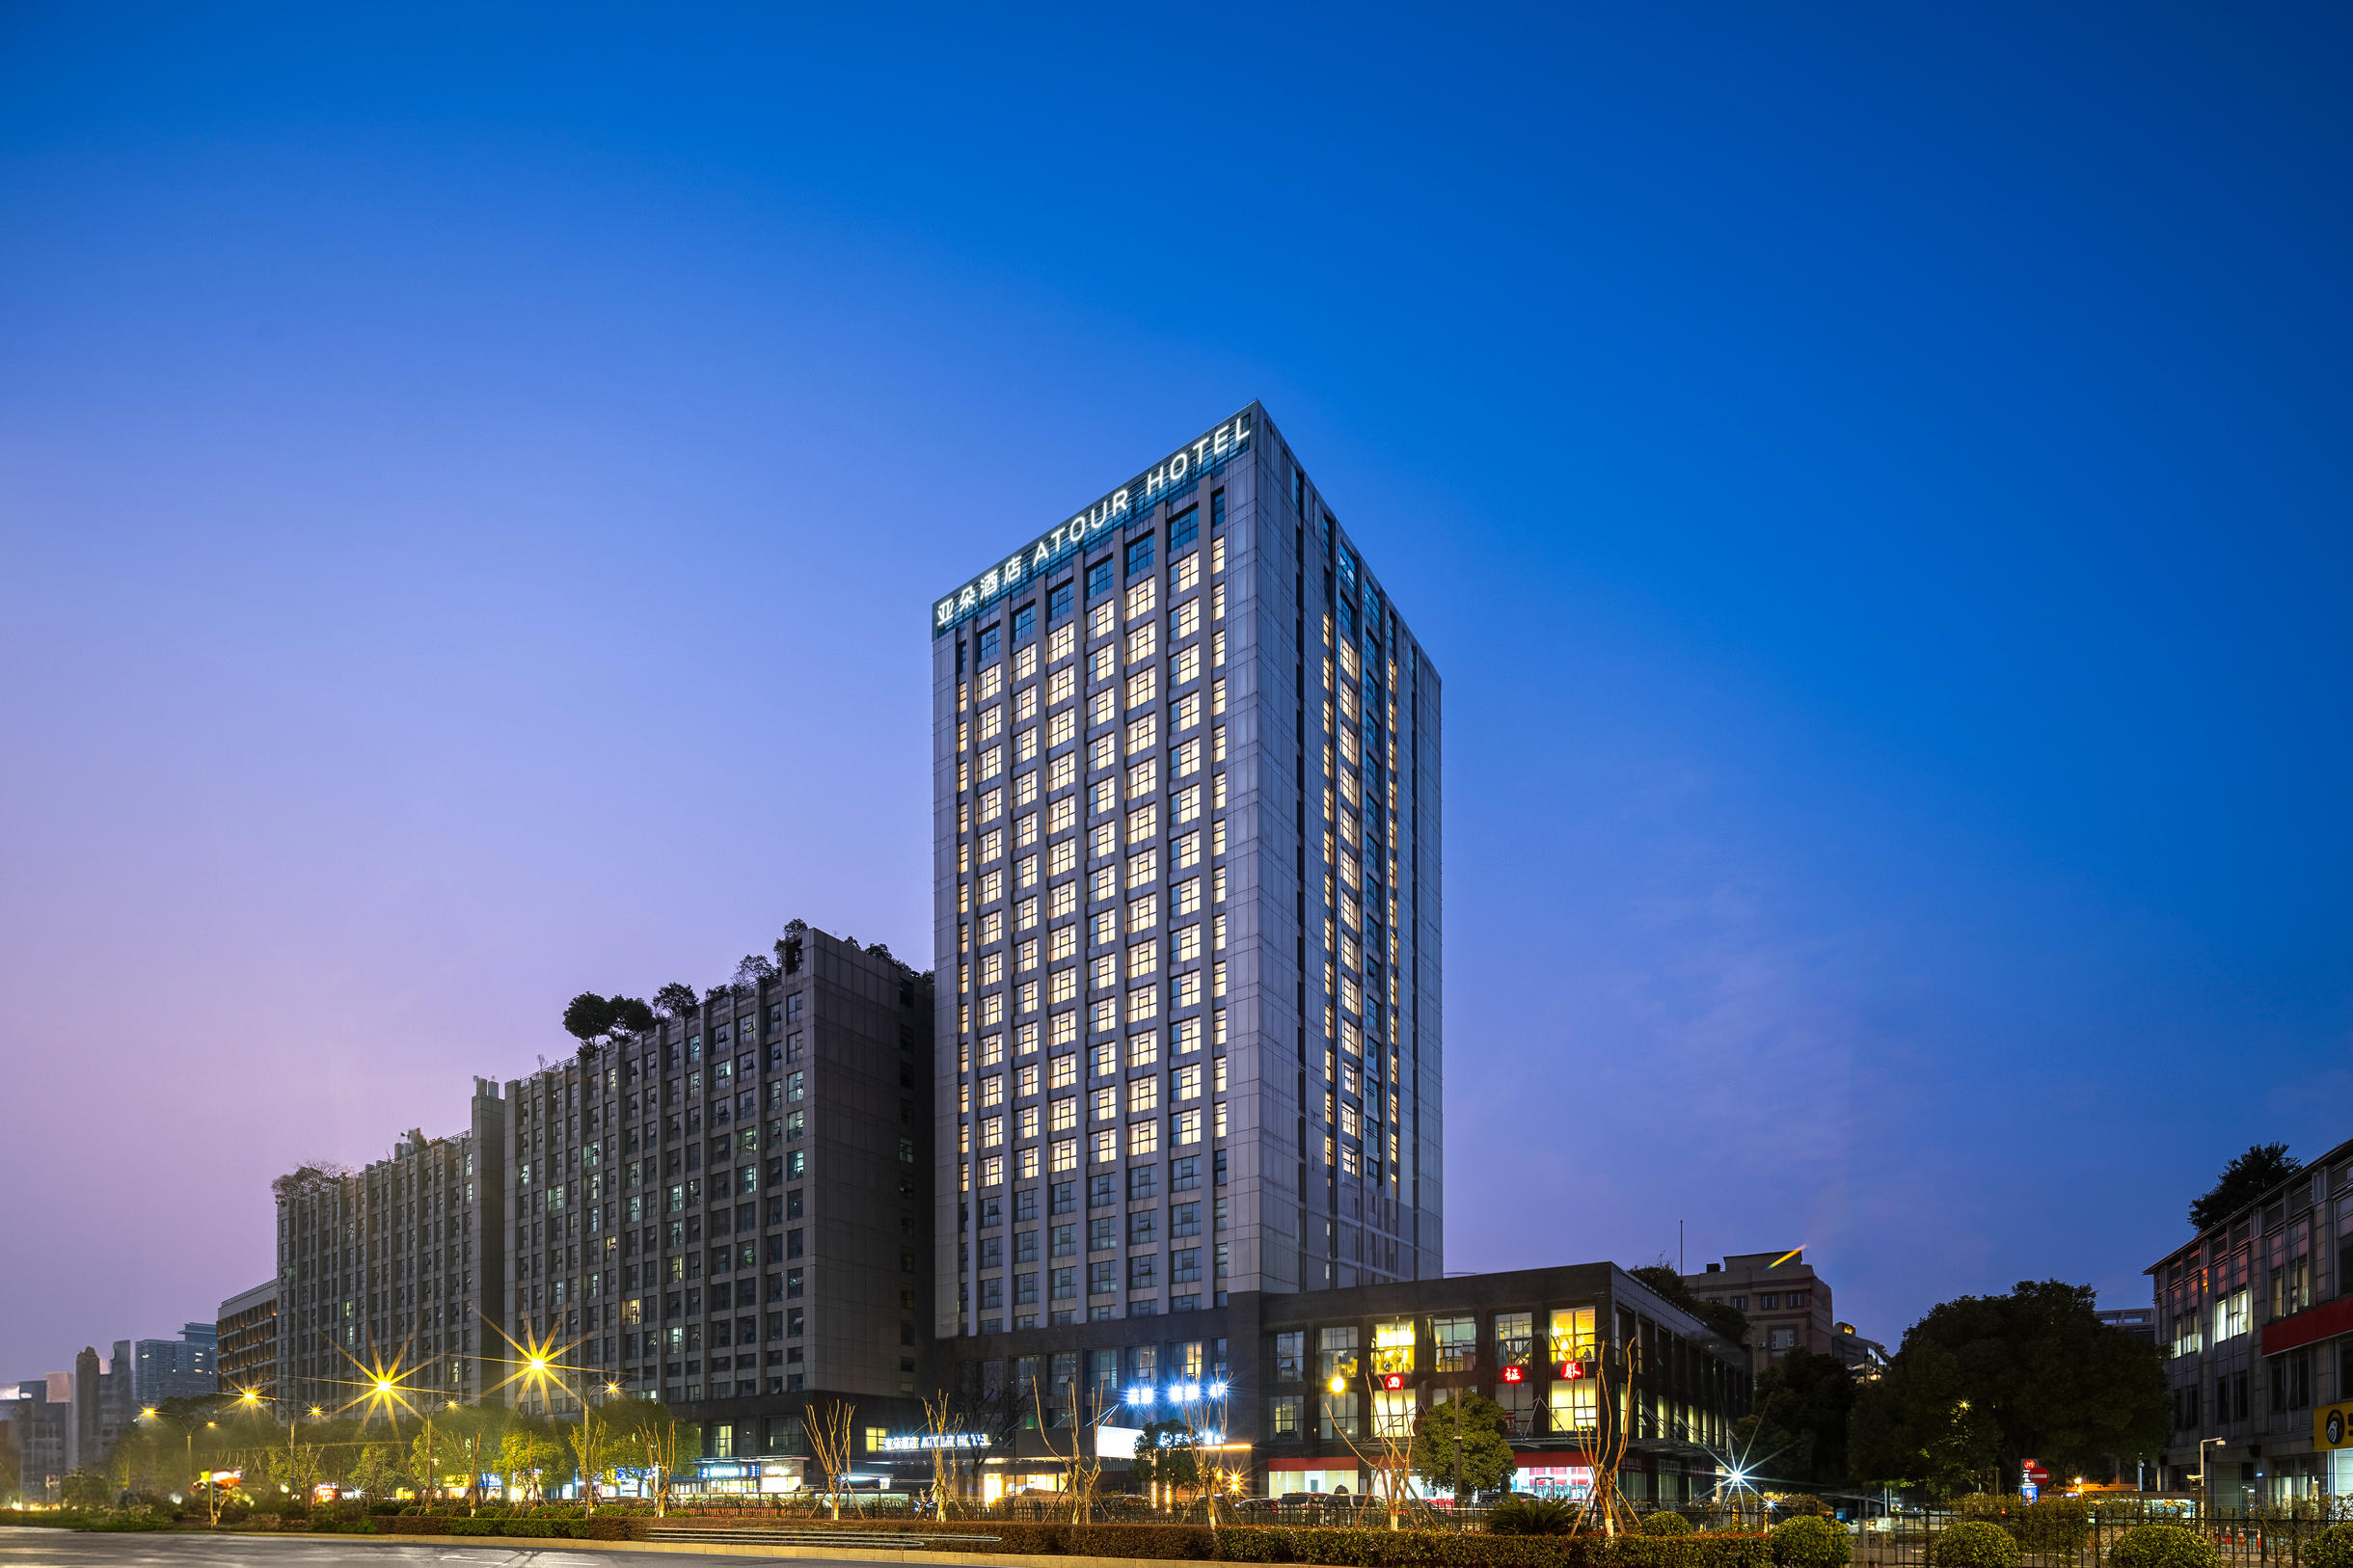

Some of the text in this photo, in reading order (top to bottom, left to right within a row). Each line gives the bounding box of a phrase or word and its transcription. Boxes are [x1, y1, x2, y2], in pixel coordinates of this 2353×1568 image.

[937, 418, 1251, 626] 亚朵酒店 ATOUR HOTEL
